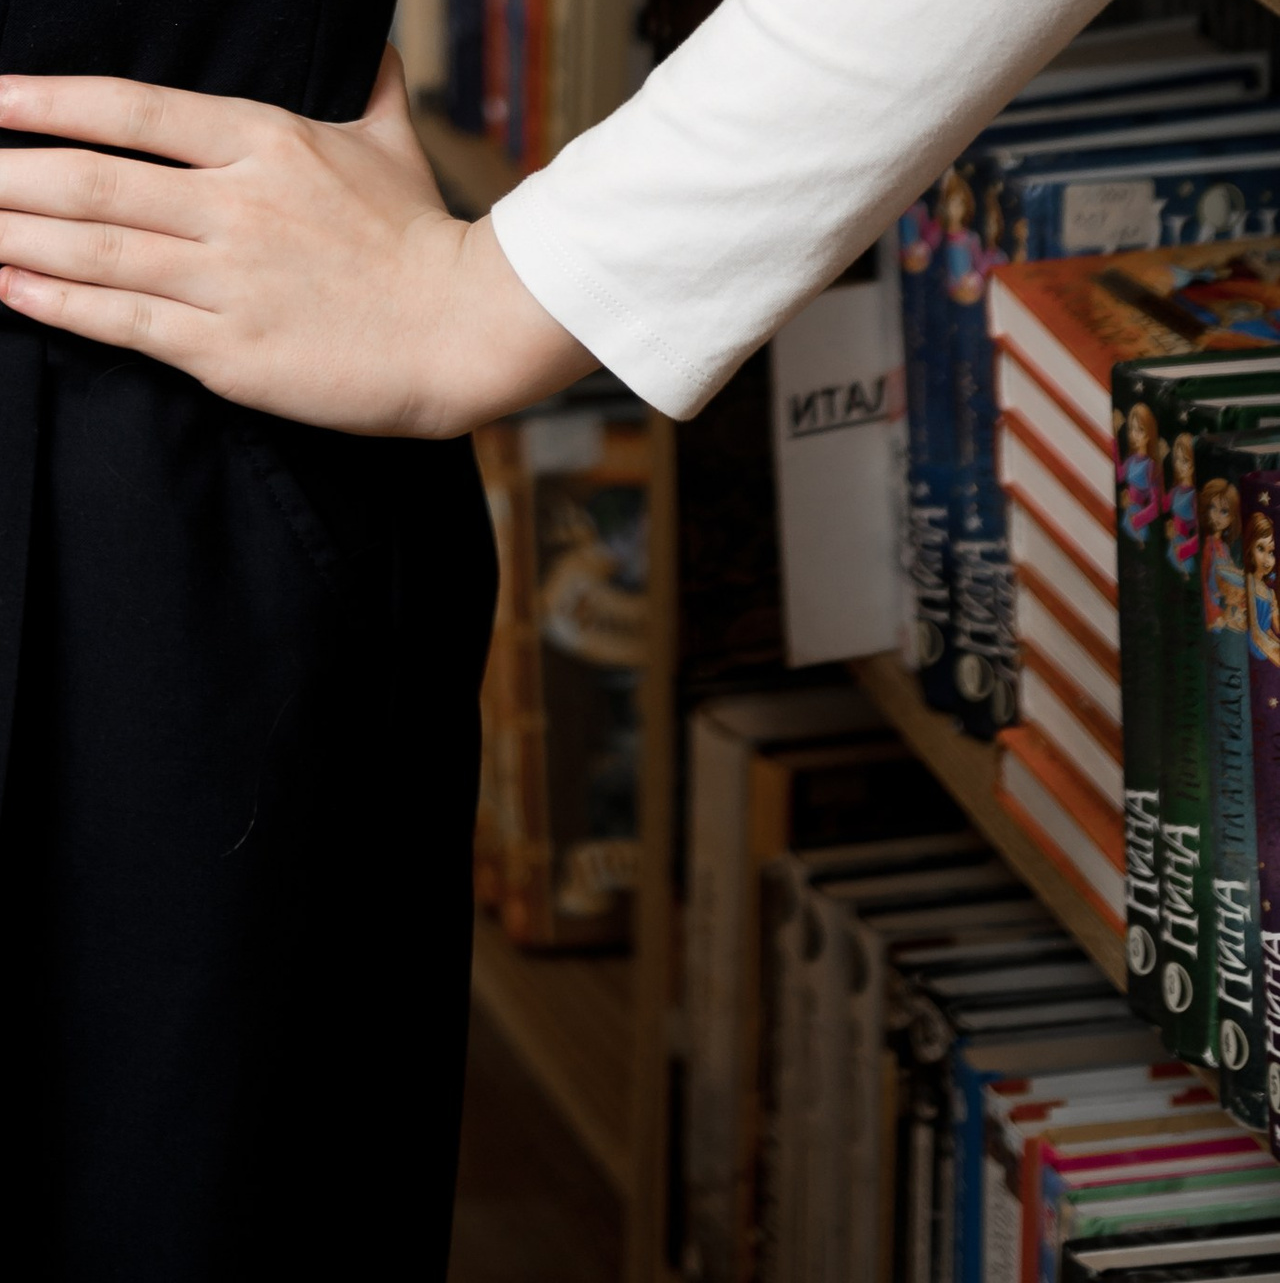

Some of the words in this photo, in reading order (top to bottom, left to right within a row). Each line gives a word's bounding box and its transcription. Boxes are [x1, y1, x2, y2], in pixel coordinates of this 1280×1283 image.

[1124, 789, 1161, 924] НИНА
[1160, 822, 1202, 961] НИНА
[1211, 877, 1253, 1017] НИНА
